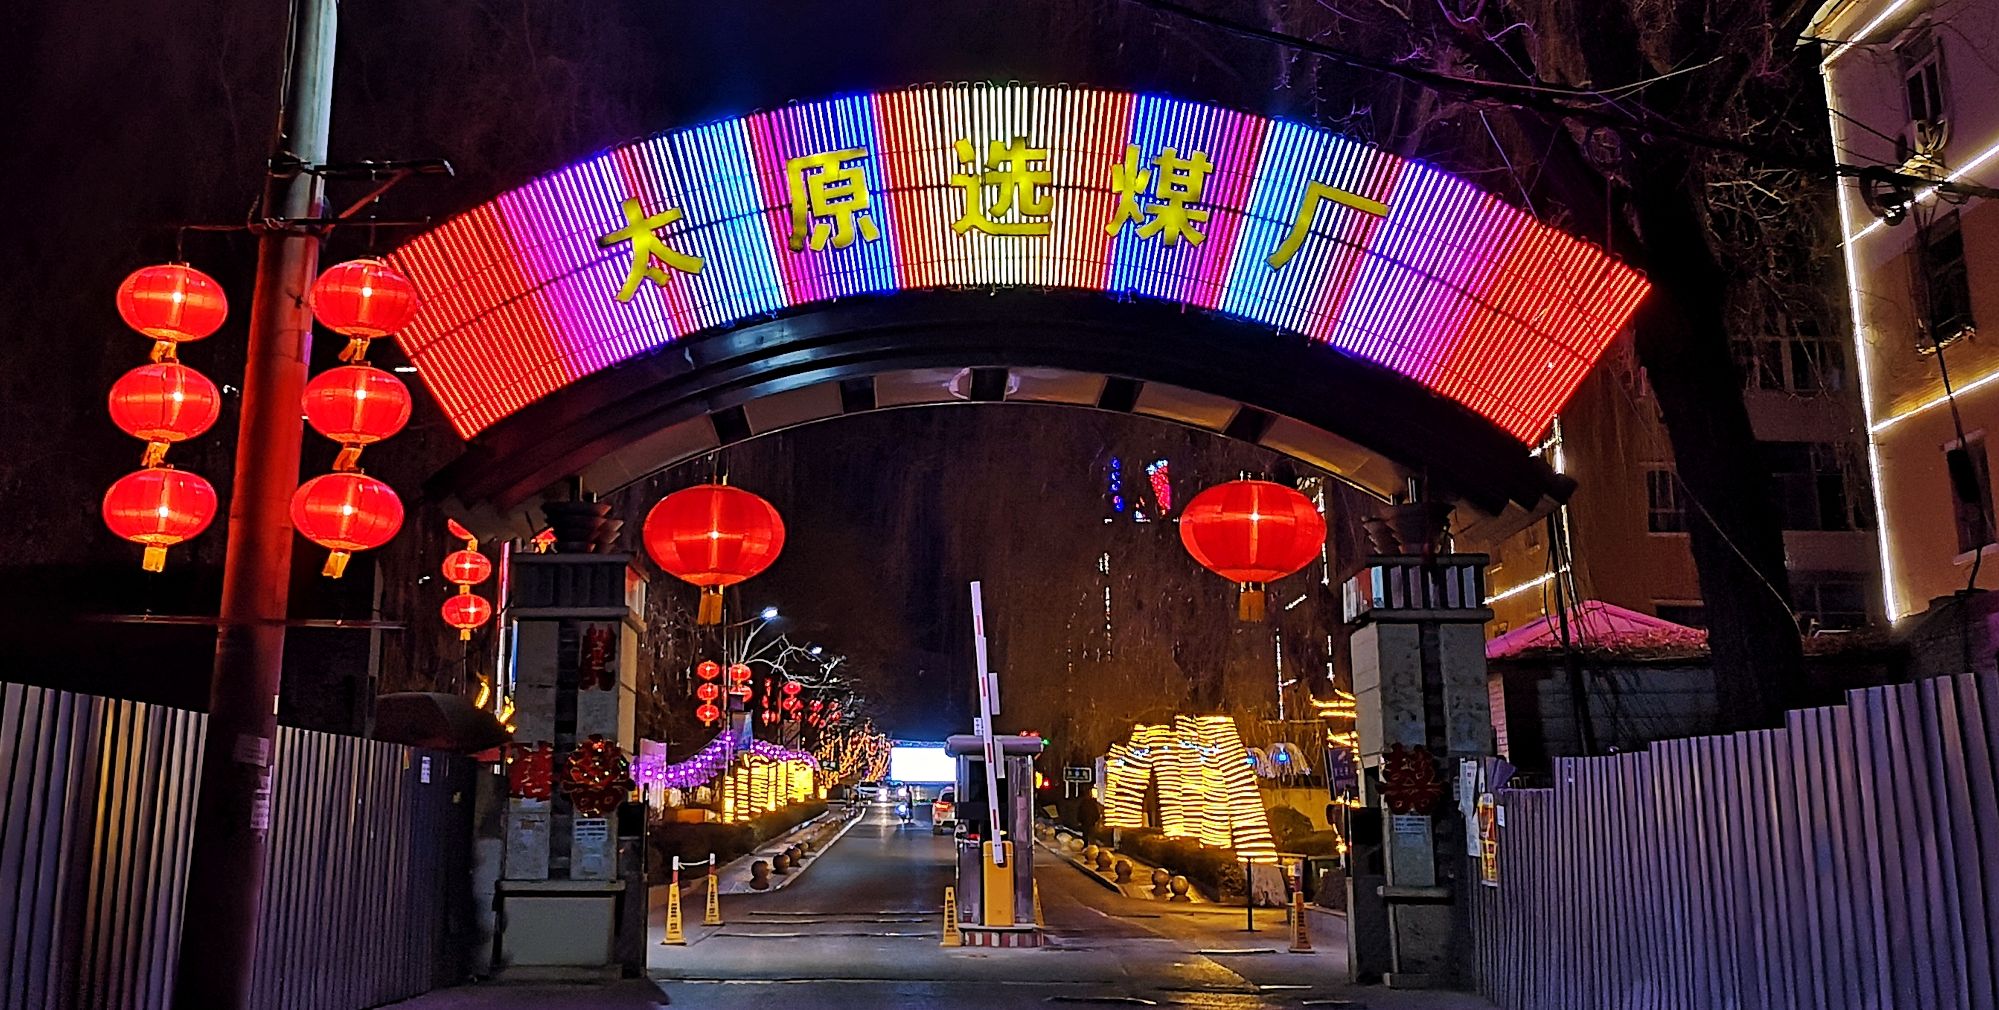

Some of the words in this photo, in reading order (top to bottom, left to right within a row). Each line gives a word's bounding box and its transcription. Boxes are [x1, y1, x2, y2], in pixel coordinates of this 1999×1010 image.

[601, 135, 1389, 303] 太原选煤厂
